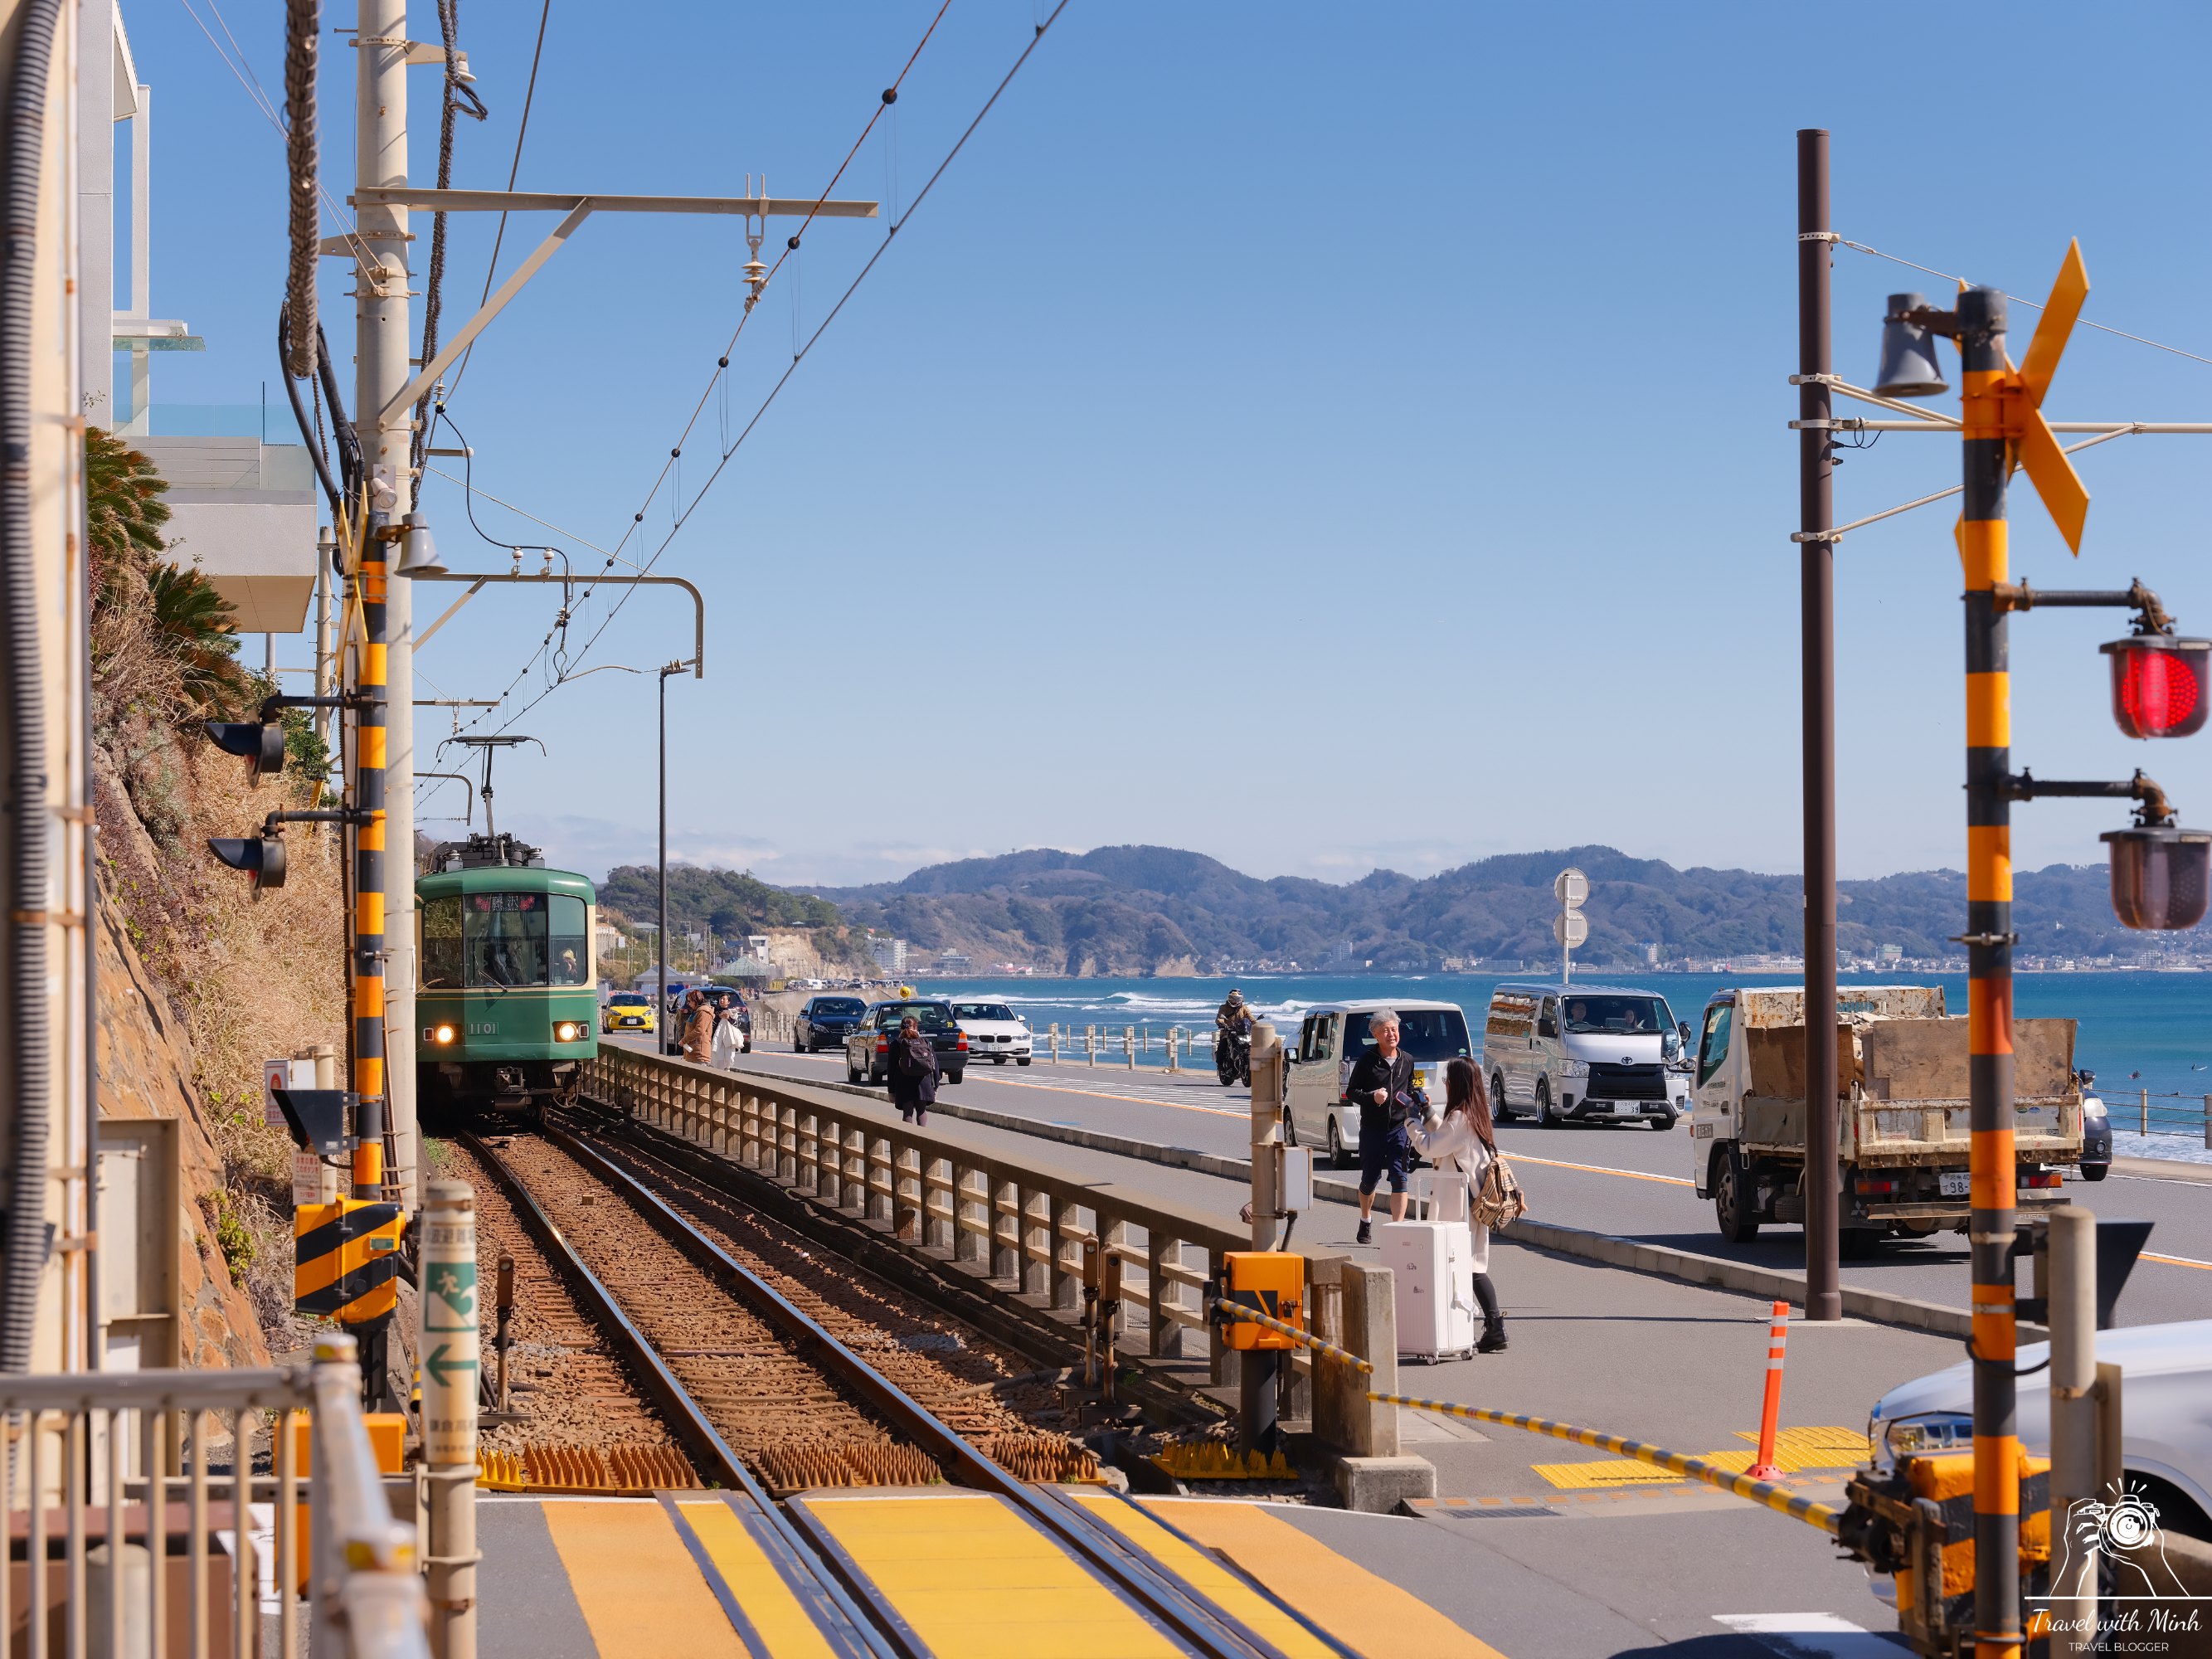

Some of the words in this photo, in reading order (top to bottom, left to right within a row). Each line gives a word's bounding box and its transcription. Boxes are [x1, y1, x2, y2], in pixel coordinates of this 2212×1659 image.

[492, 893, 518, 907] 藤沢
[470, 1023, 497, 1034] 1101
[1413, 1078, 1423, 1086] 25
[1950, 1182, 1968, 1193] 98-
